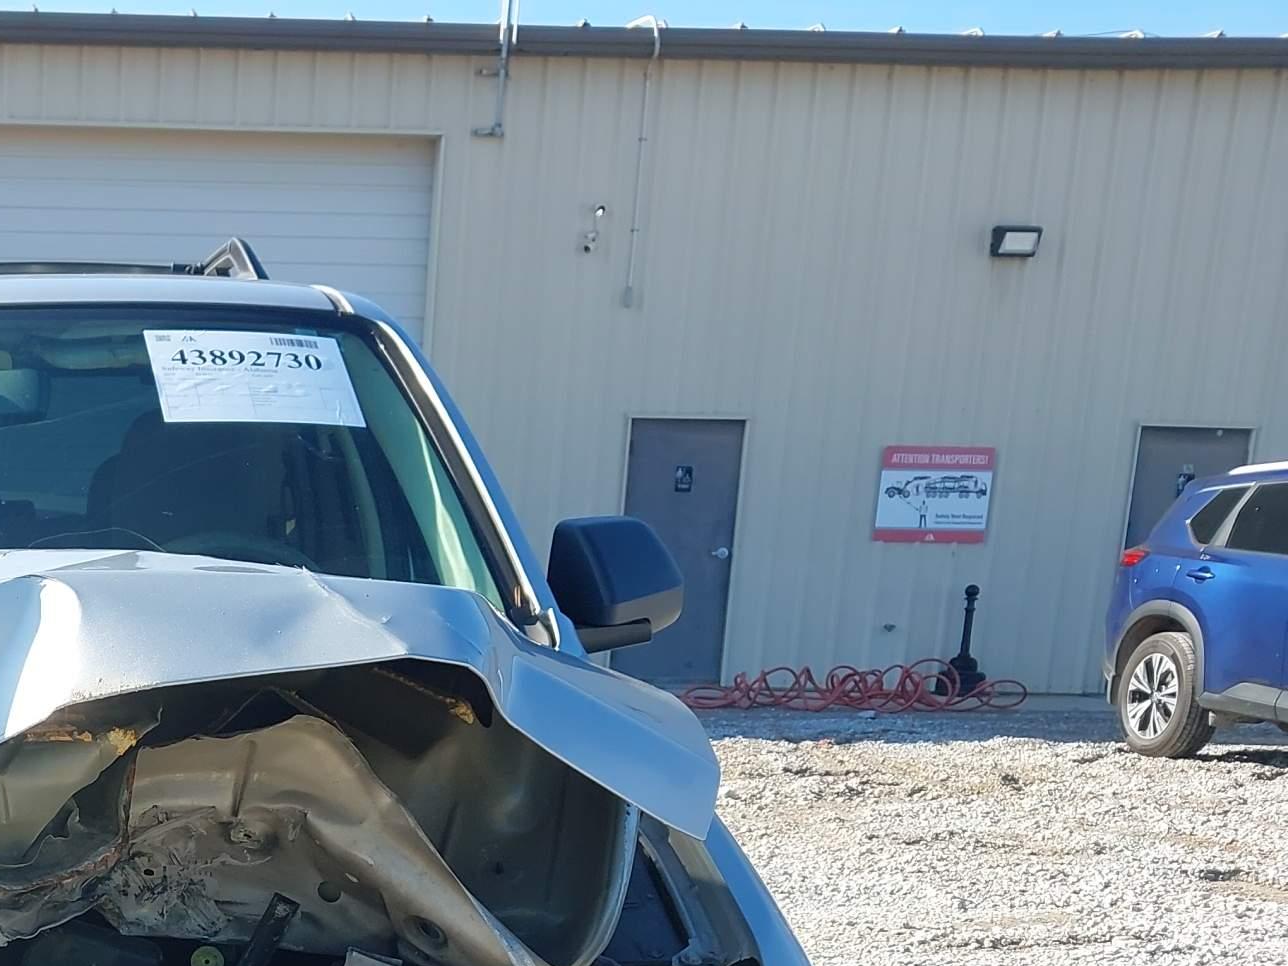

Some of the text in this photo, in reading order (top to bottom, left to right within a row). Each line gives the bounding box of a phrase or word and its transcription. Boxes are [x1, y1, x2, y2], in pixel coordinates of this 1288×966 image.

[171, 349, 322, 370] 43892730
[891, 453, 989, 465] ATTENTION TRANSPORTERS!
